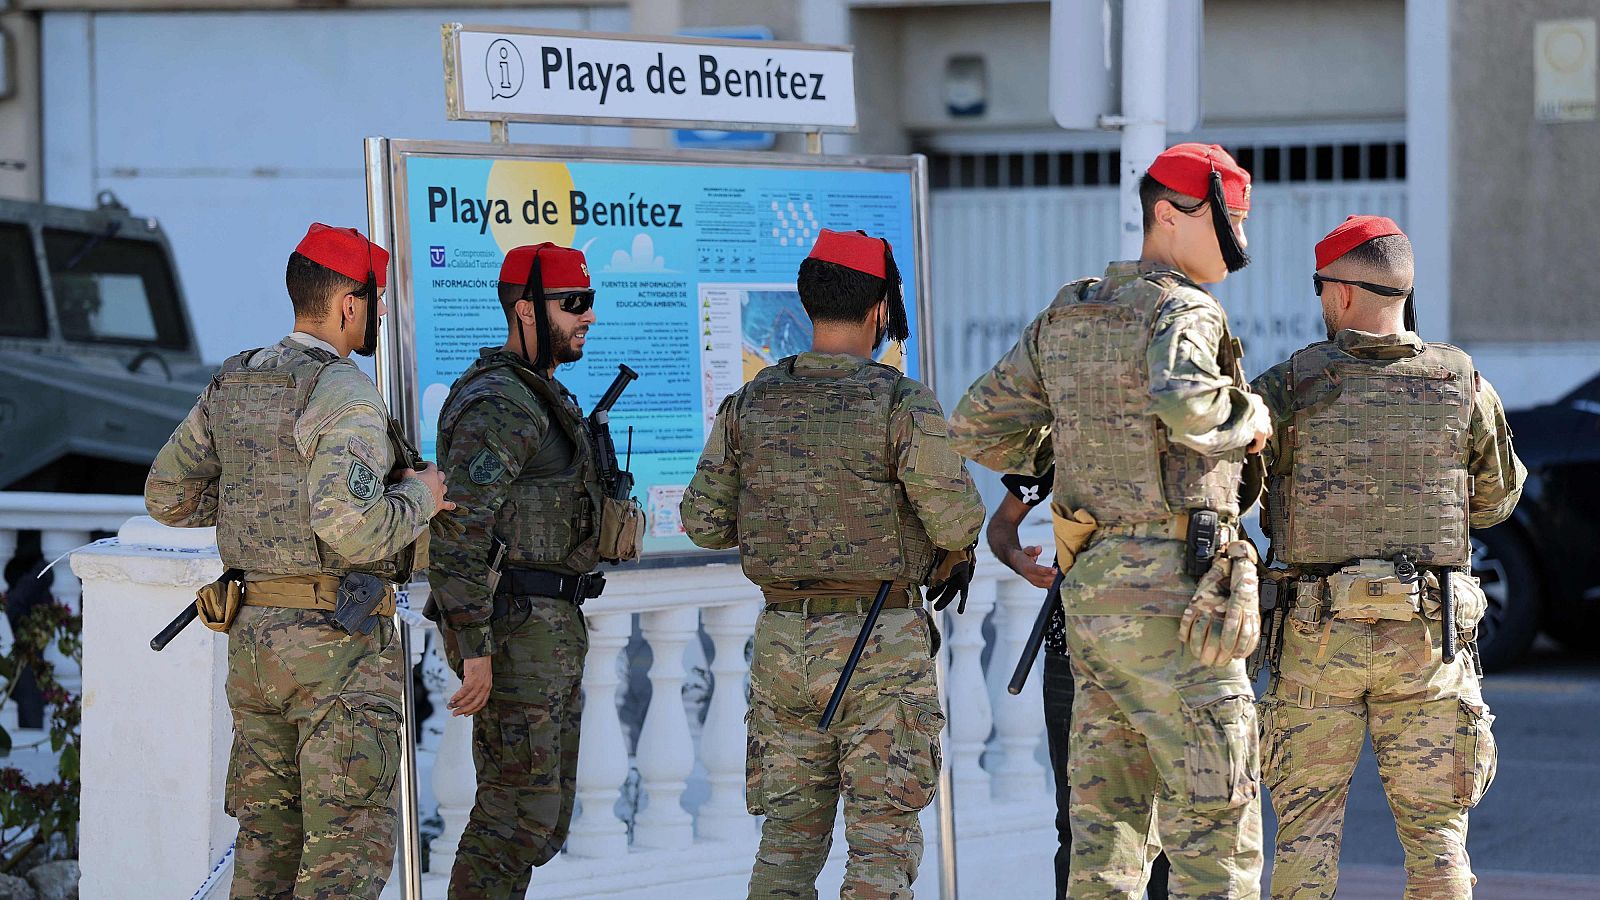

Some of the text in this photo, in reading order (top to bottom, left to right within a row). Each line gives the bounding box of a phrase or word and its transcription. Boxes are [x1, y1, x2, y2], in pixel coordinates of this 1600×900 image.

[541, 46, 826, 105] Playa de Benítez
[427, 186, 512, 235] Playa
[522, 189, 559, 225] de
[569, 190, 683, 228] Benítez
[453, 248, 496, 258] Compromiso
[432, 277, 488, 289] INFORMACIÓN
[601, 281, 629, 289] FUENTES
[629, 281, 638, 289] DE
[639, 279, 682, 289] INFORMACIÓN
[616, 300, 653, 308] EDUCACIÓN
